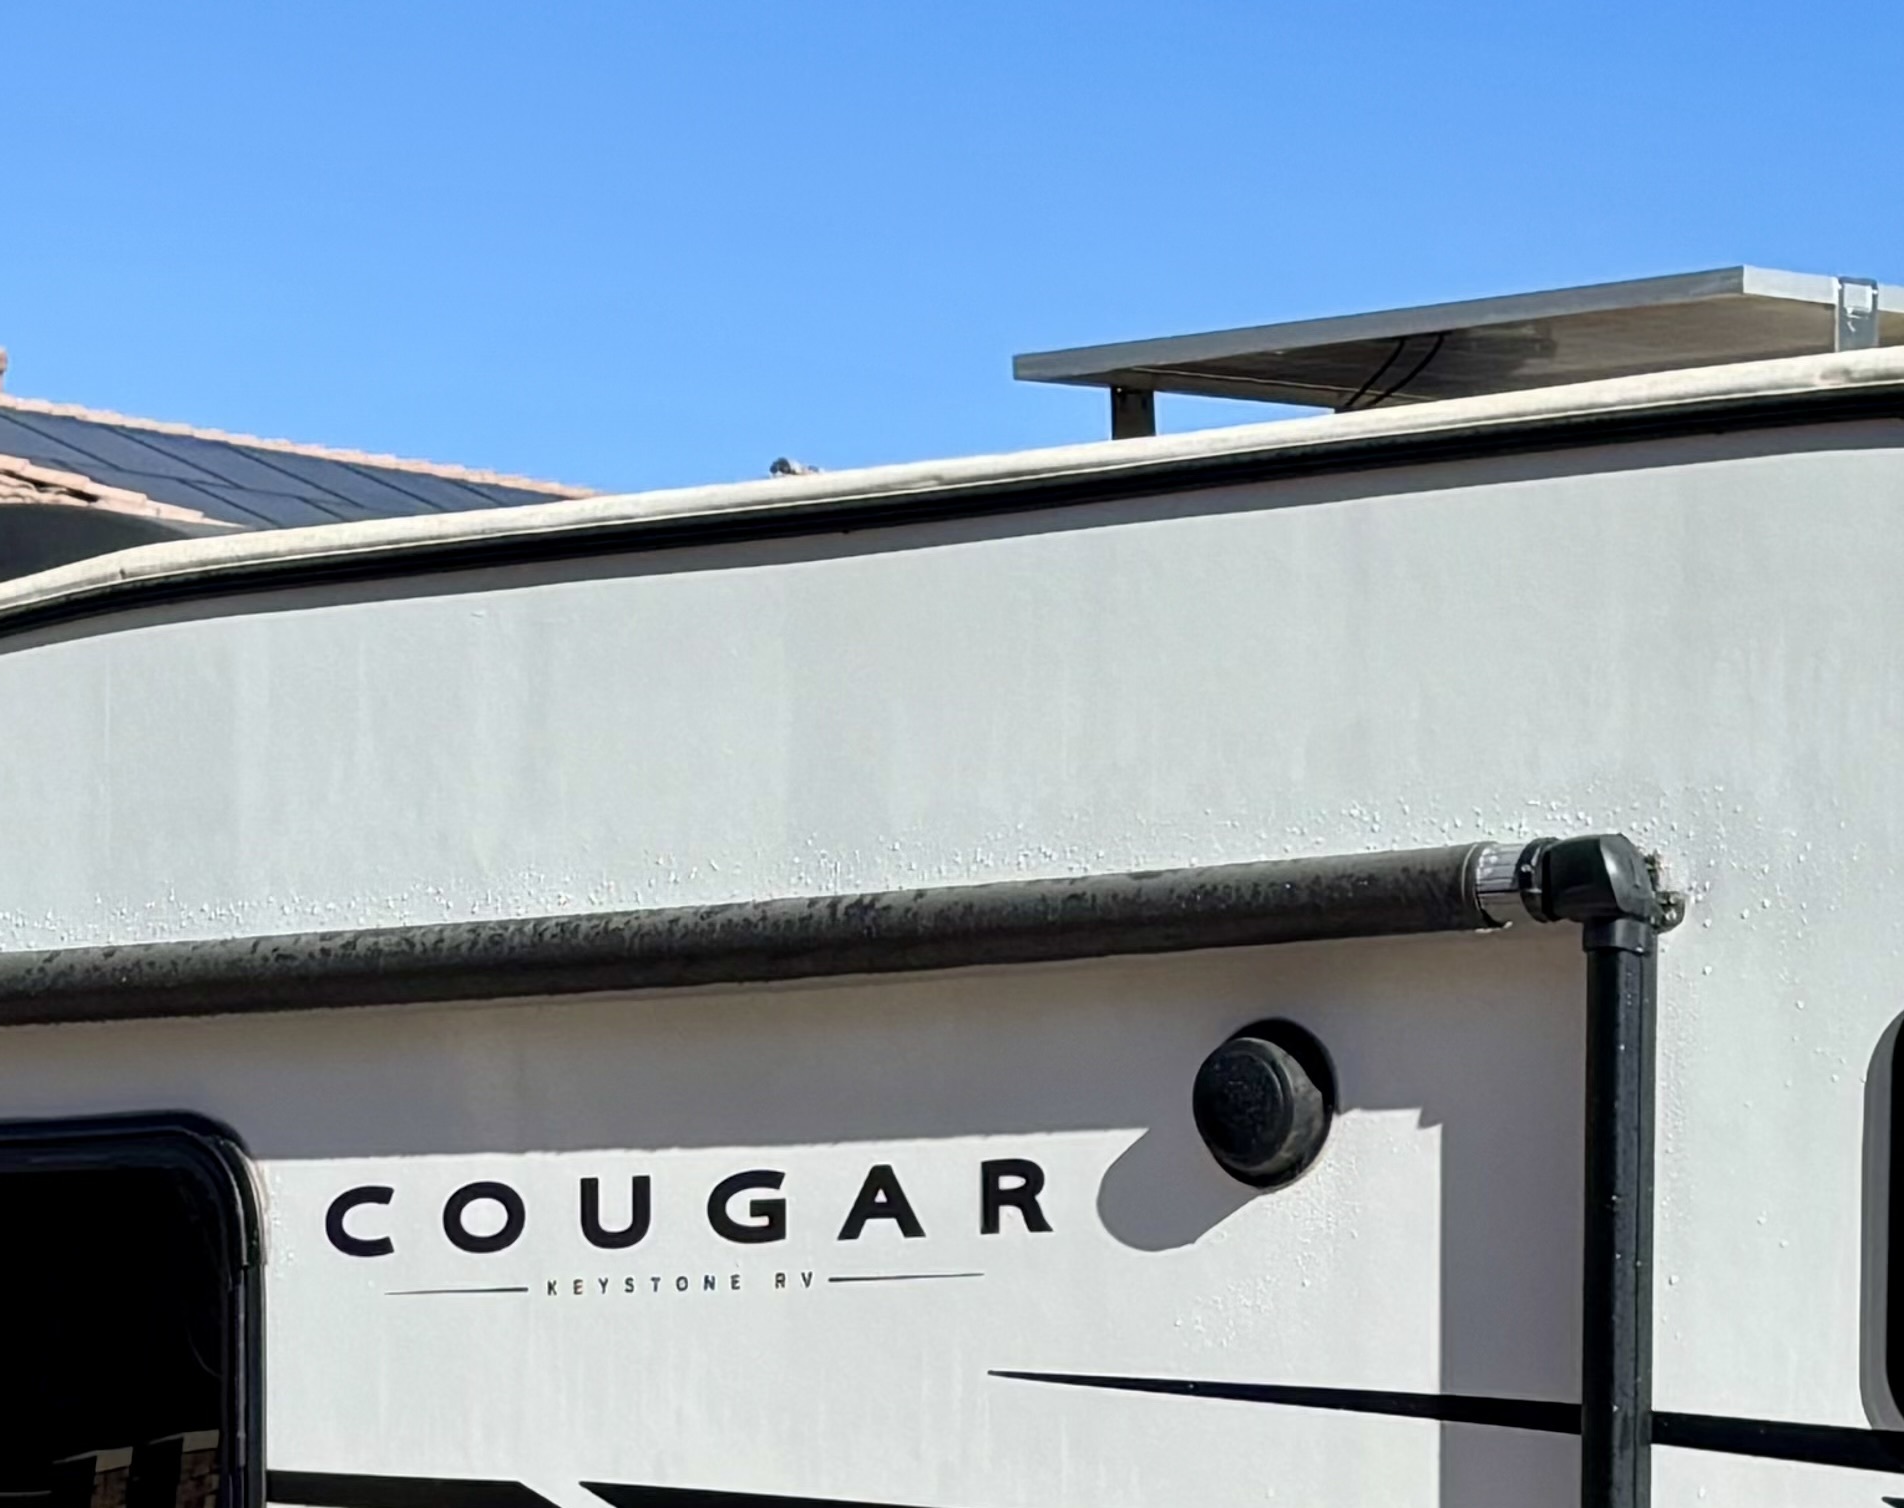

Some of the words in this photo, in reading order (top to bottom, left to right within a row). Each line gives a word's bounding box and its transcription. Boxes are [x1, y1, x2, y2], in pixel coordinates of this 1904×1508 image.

[325, 1158, 1053, 1258] COUGAR
[547, 1273, 741, 1296] KEYSTONE
[774, 1271, 813, 1290] RV
